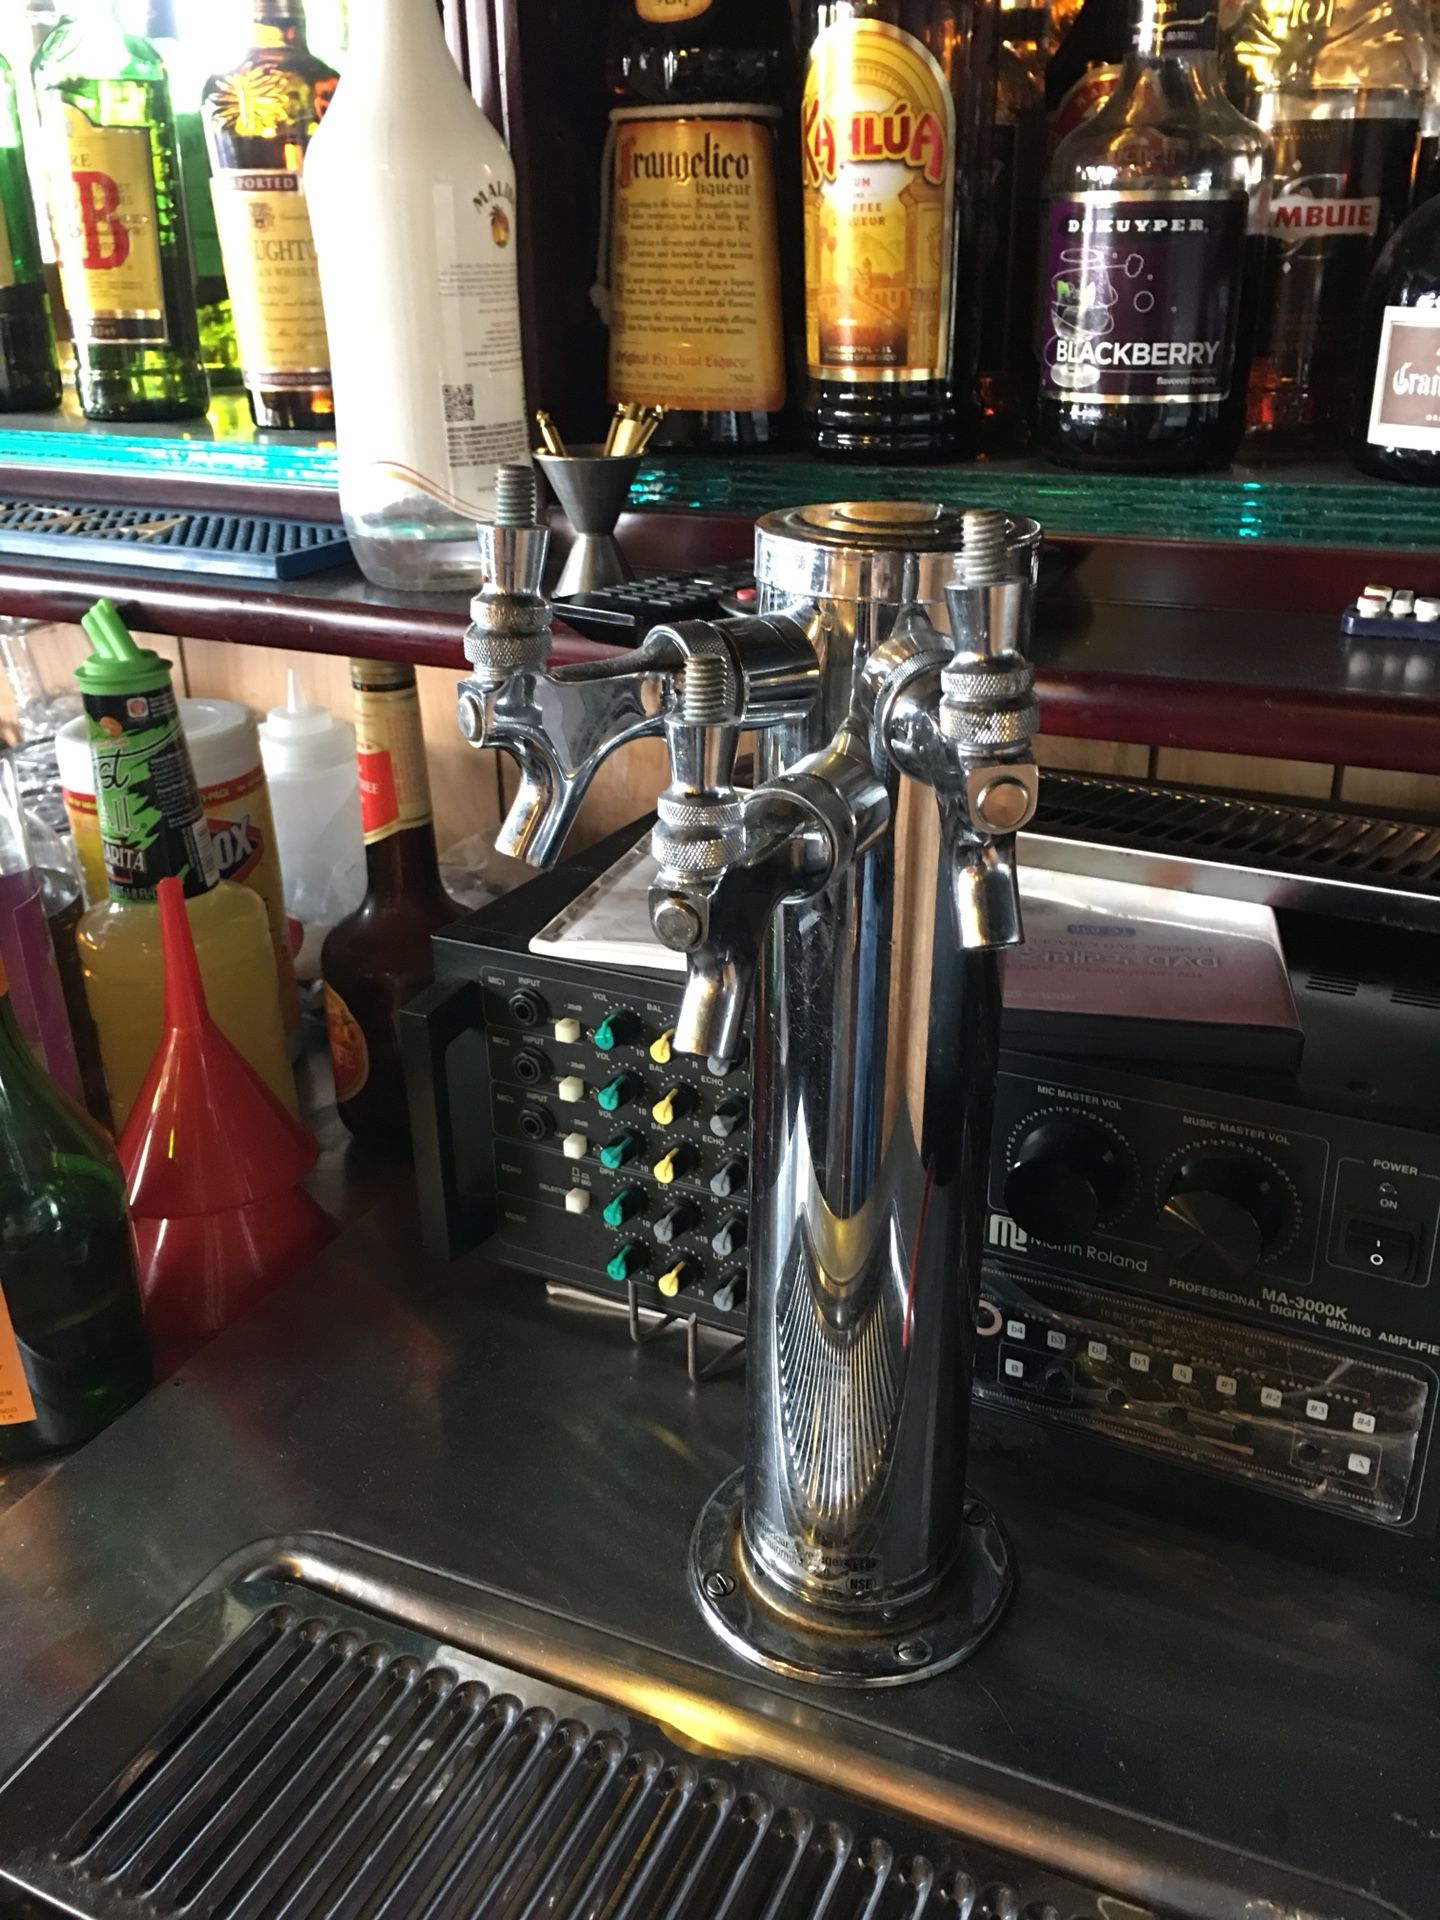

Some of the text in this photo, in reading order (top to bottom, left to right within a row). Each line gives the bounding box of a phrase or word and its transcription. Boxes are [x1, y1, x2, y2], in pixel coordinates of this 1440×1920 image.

[620, 132, 750, 188] Frangelico
[236, 177, 294, 189] PORTED
[1275, 205, 1373, 227] MBUIE
[1056, 340, 1220, 366] BLACKBERRY
[104, 843, 146, 872] ARITA
[647, 1003, 663, 1014] BAL
[701, 1075, 724, 1086] ECHO
[1037, 1085, 1122, 1111] MIC MASTER VOL
[702, 1135, 725, 1146] ECHO
[1183, 1115, 1290, 1146] MUSIC MASTER VOL
[1373, 1158, 1418, 1176] POWER
[1380, 1198, 1398, 1210] ON
[1086, 1245, 1148, 1273] Roland
[1169, 1278, 1440, 1356] PROFESSIONAL DIGITAL MIXING AMPLIFIE
[1262, 1288, 1348, 1321] MA-3000K
